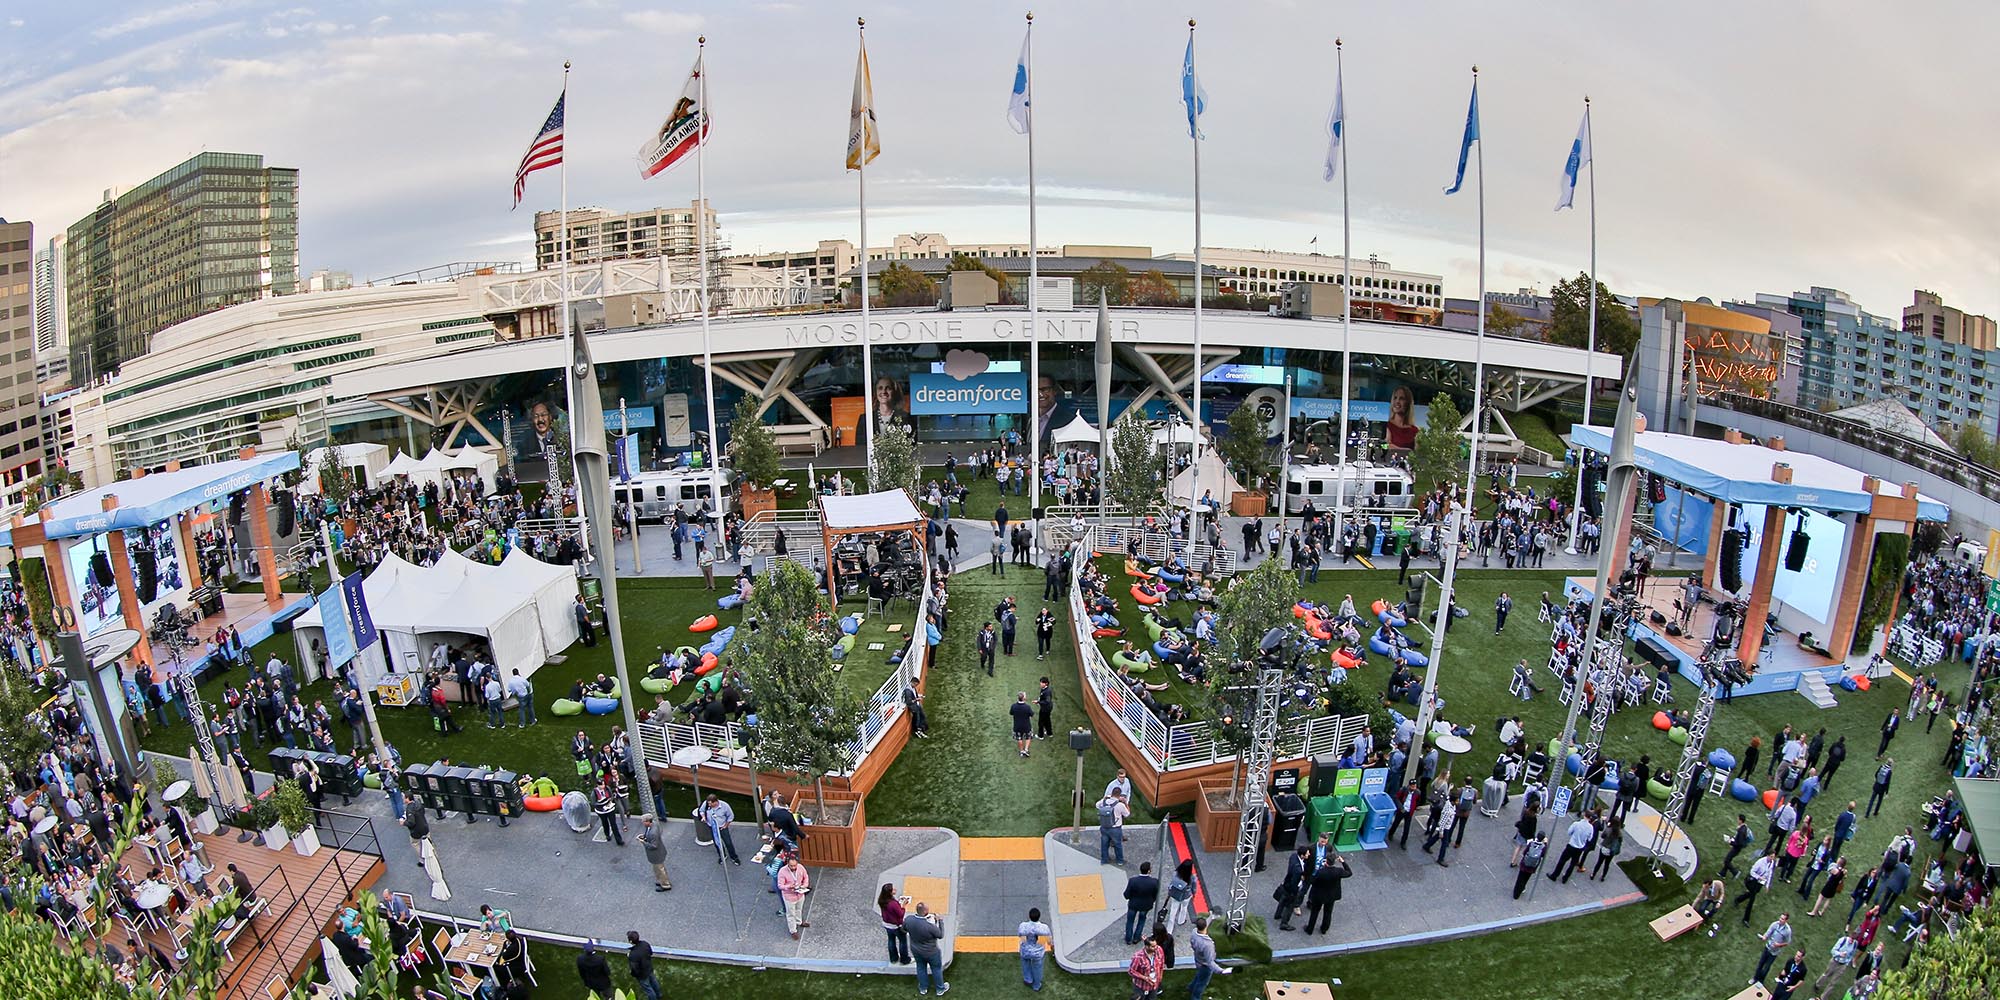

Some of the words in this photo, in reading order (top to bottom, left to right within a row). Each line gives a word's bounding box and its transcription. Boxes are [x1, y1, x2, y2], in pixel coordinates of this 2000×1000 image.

[785, 320, 962, 345] MOSCONE
[993, 319, 1140, 340] CENTR
[915, 384, 1022, 407] dreamforce
[1304, 400, 1316, 408] Get
[1316, 402, 1335, 410] ready
[1364, 404, 1378, 412] kind
[1259, 407, 1274, 418] 72
[203, 472, 251, 498] dreamforce
[75, 516, 107, 532] dreamforce
[351, 586, 367, 635] dreamforce
